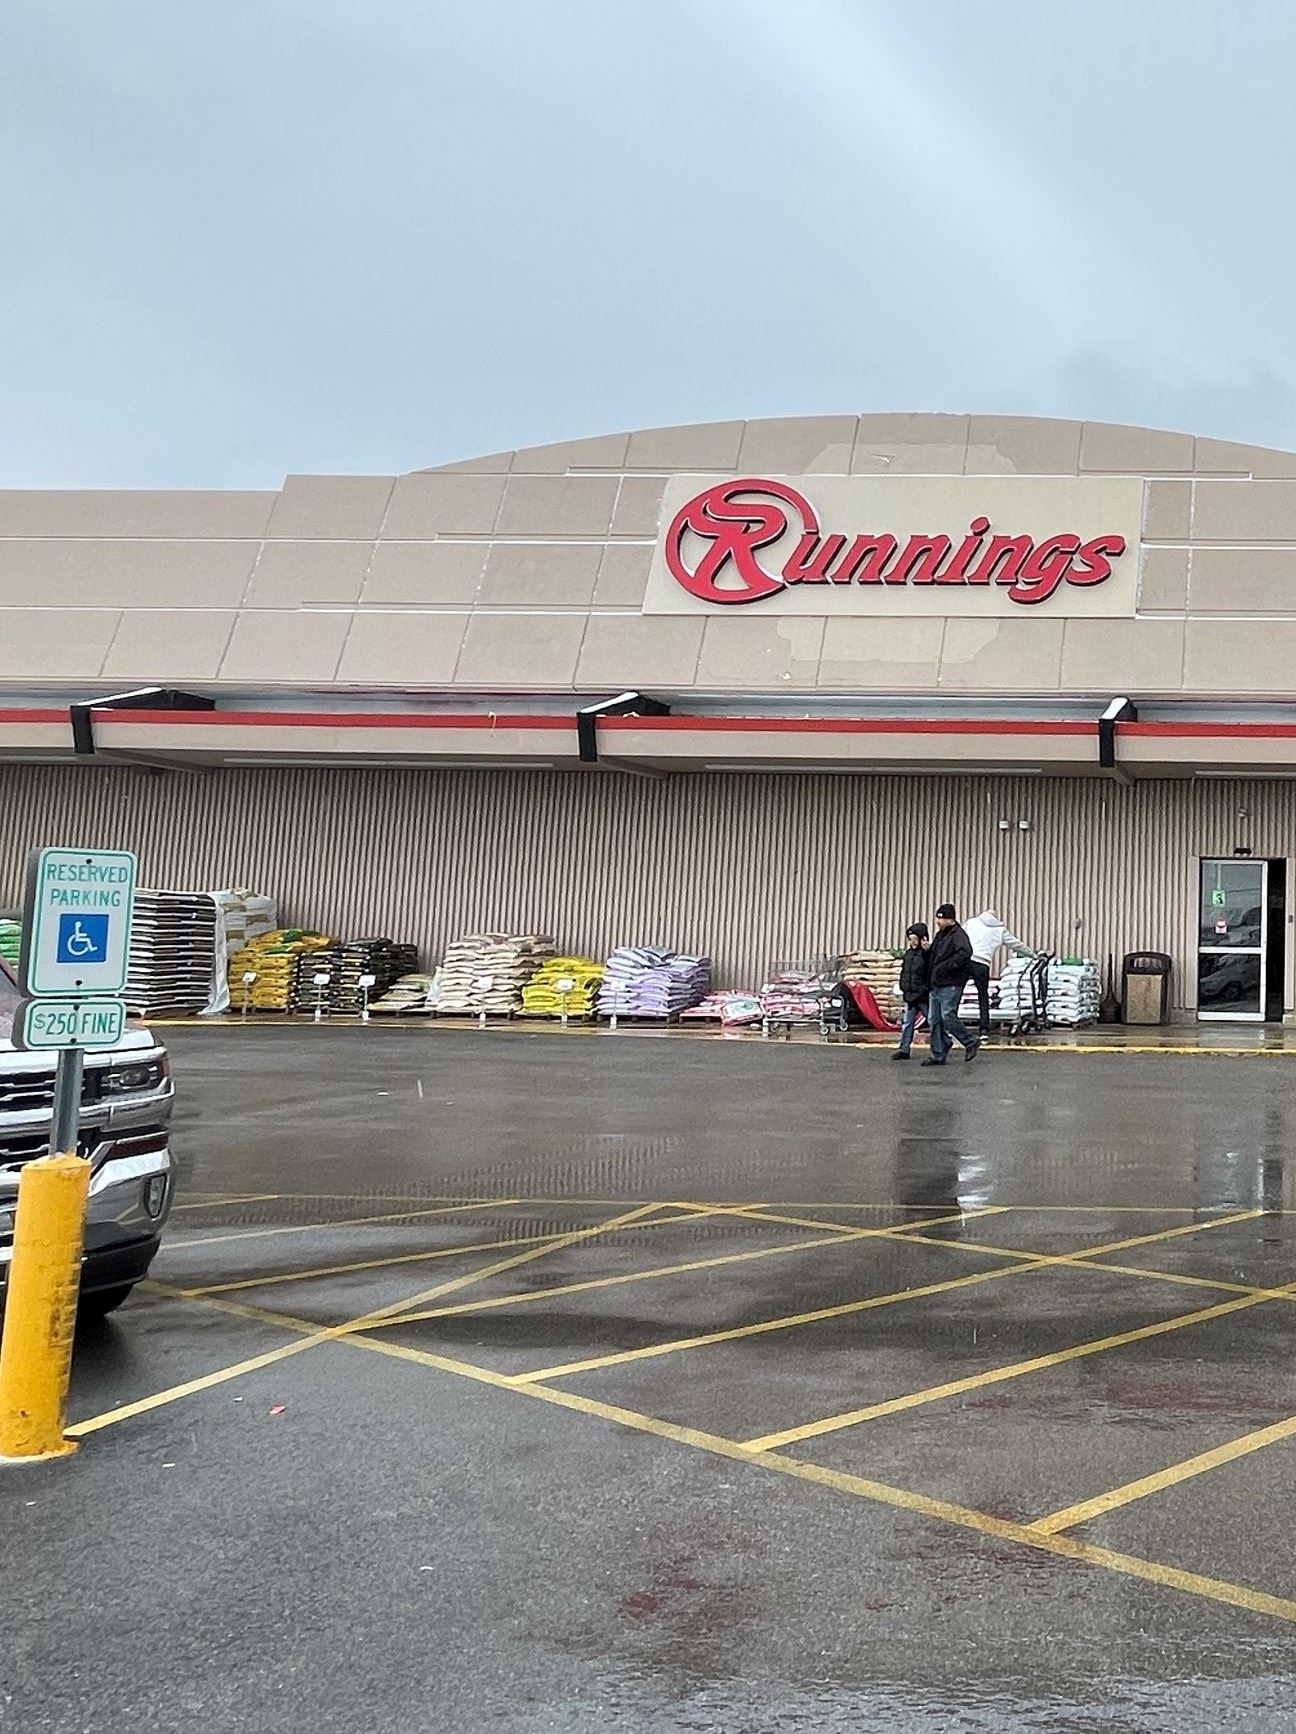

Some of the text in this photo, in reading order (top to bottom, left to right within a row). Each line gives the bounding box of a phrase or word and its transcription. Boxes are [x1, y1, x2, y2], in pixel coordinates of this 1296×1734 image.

[666, 479, 1125, 604] Runnings
[47, 864, 128, 883] RESERVED
[50, 889, 121, 907] PARKING
[34, 1013, 118, 1036] $250 FINE
